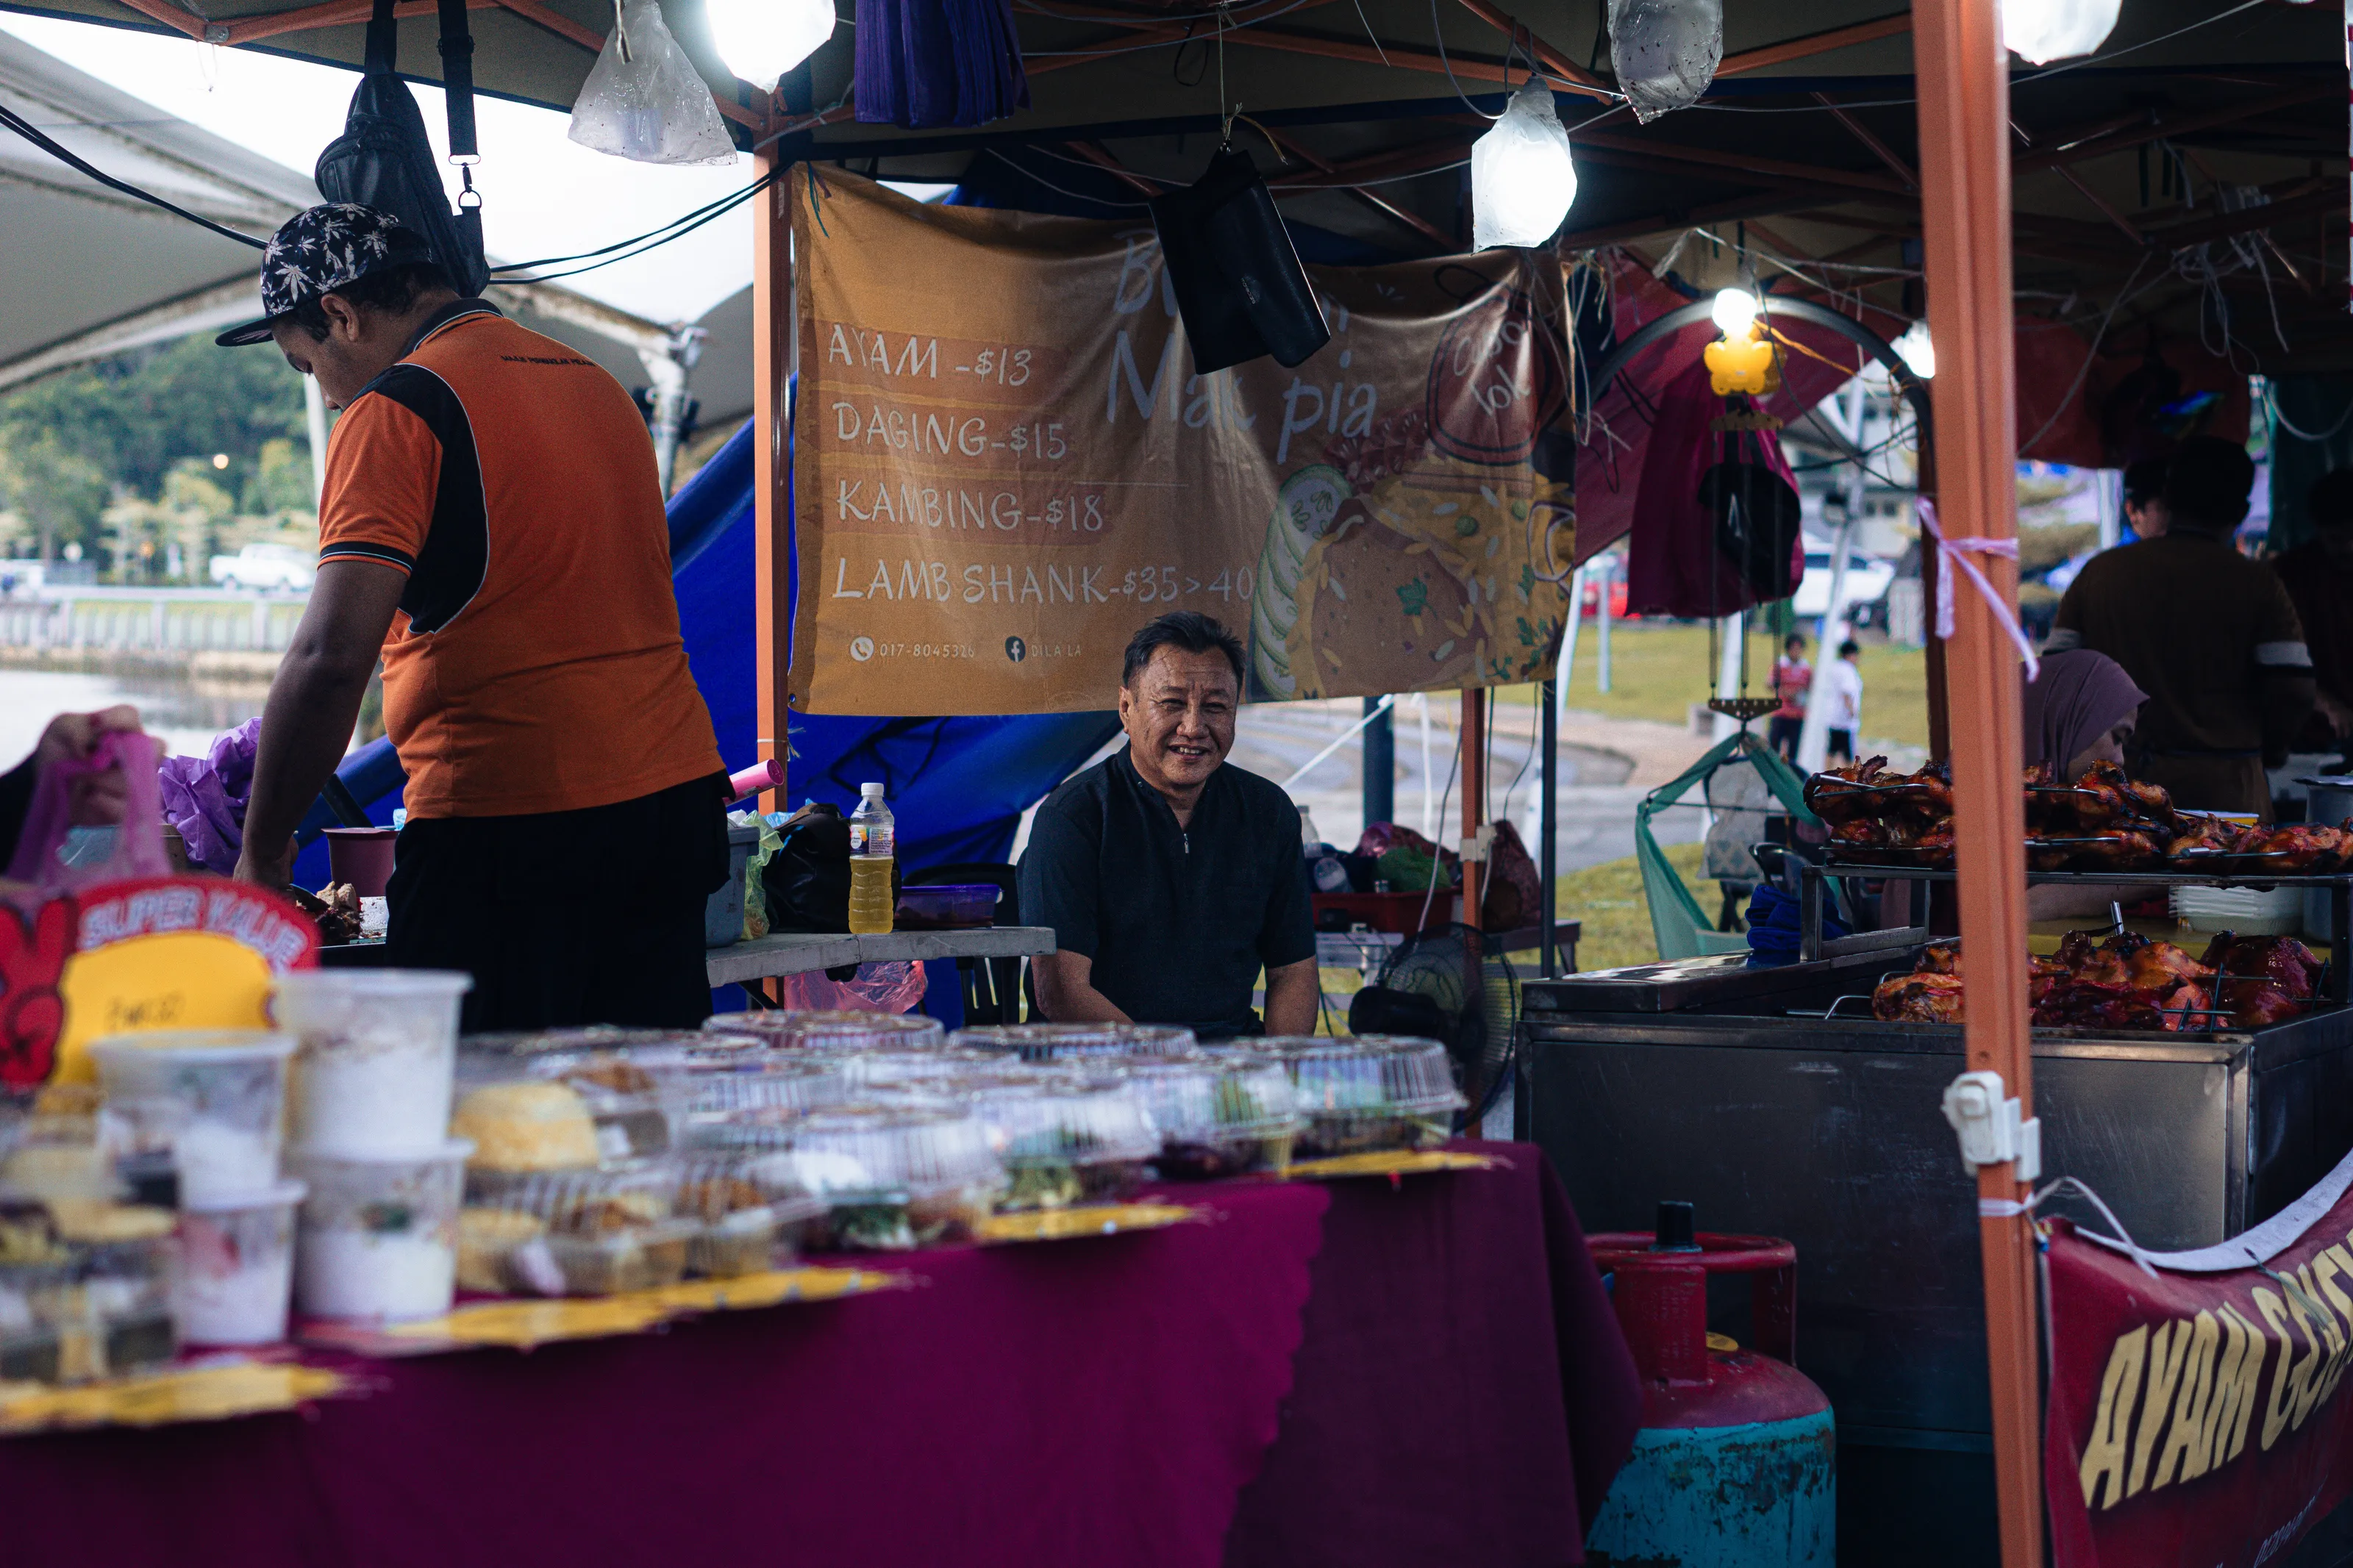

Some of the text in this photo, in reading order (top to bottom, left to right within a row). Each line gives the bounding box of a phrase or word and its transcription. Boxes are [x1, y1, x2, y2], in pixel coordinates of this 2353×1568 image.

[829, 324, 938, 379] AYAM
[1276, 349, 1377, 465] pia
[832, 557, 951, 602] LAMB
[2079, 1300, 2266, 1511] AYAM
